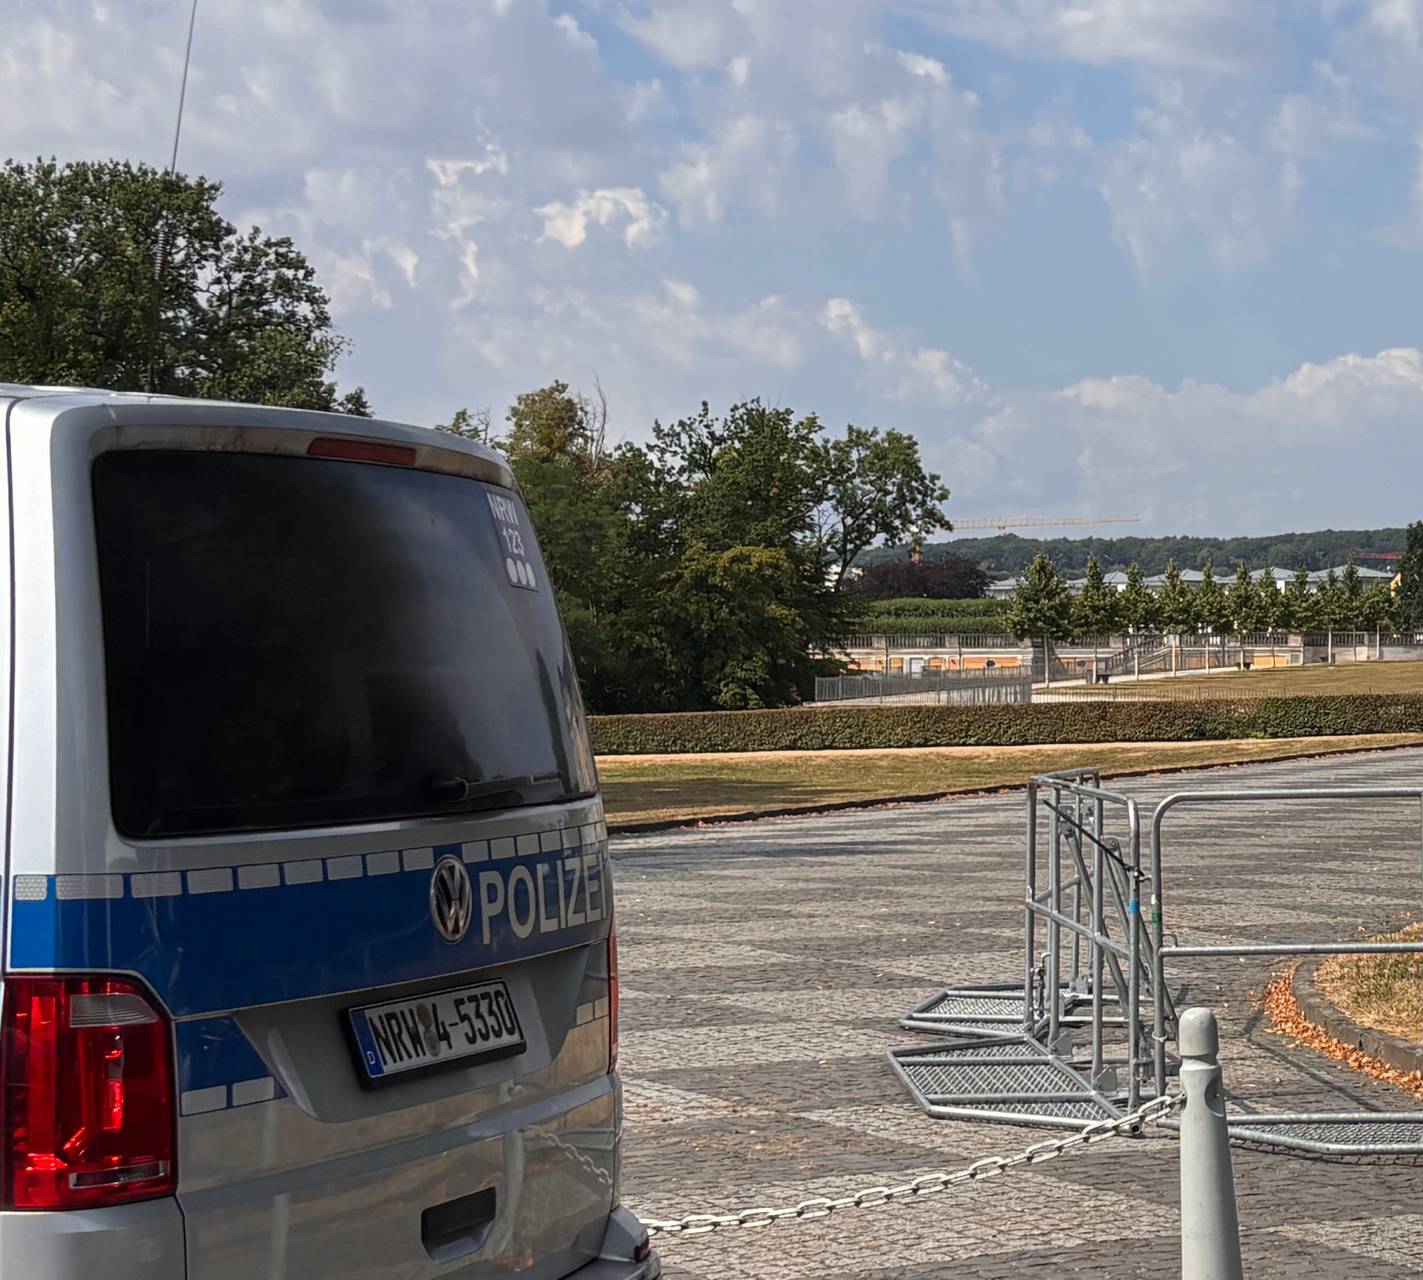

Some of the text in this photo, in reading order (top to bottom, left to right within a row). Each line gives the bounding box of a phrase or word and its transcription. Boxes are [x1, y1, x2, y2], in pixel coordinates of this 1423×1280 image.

[486, 492, 519, 526] NRW
[503, 527, 525, 556] 123
[368, 1007, 427, 1066] NRW
